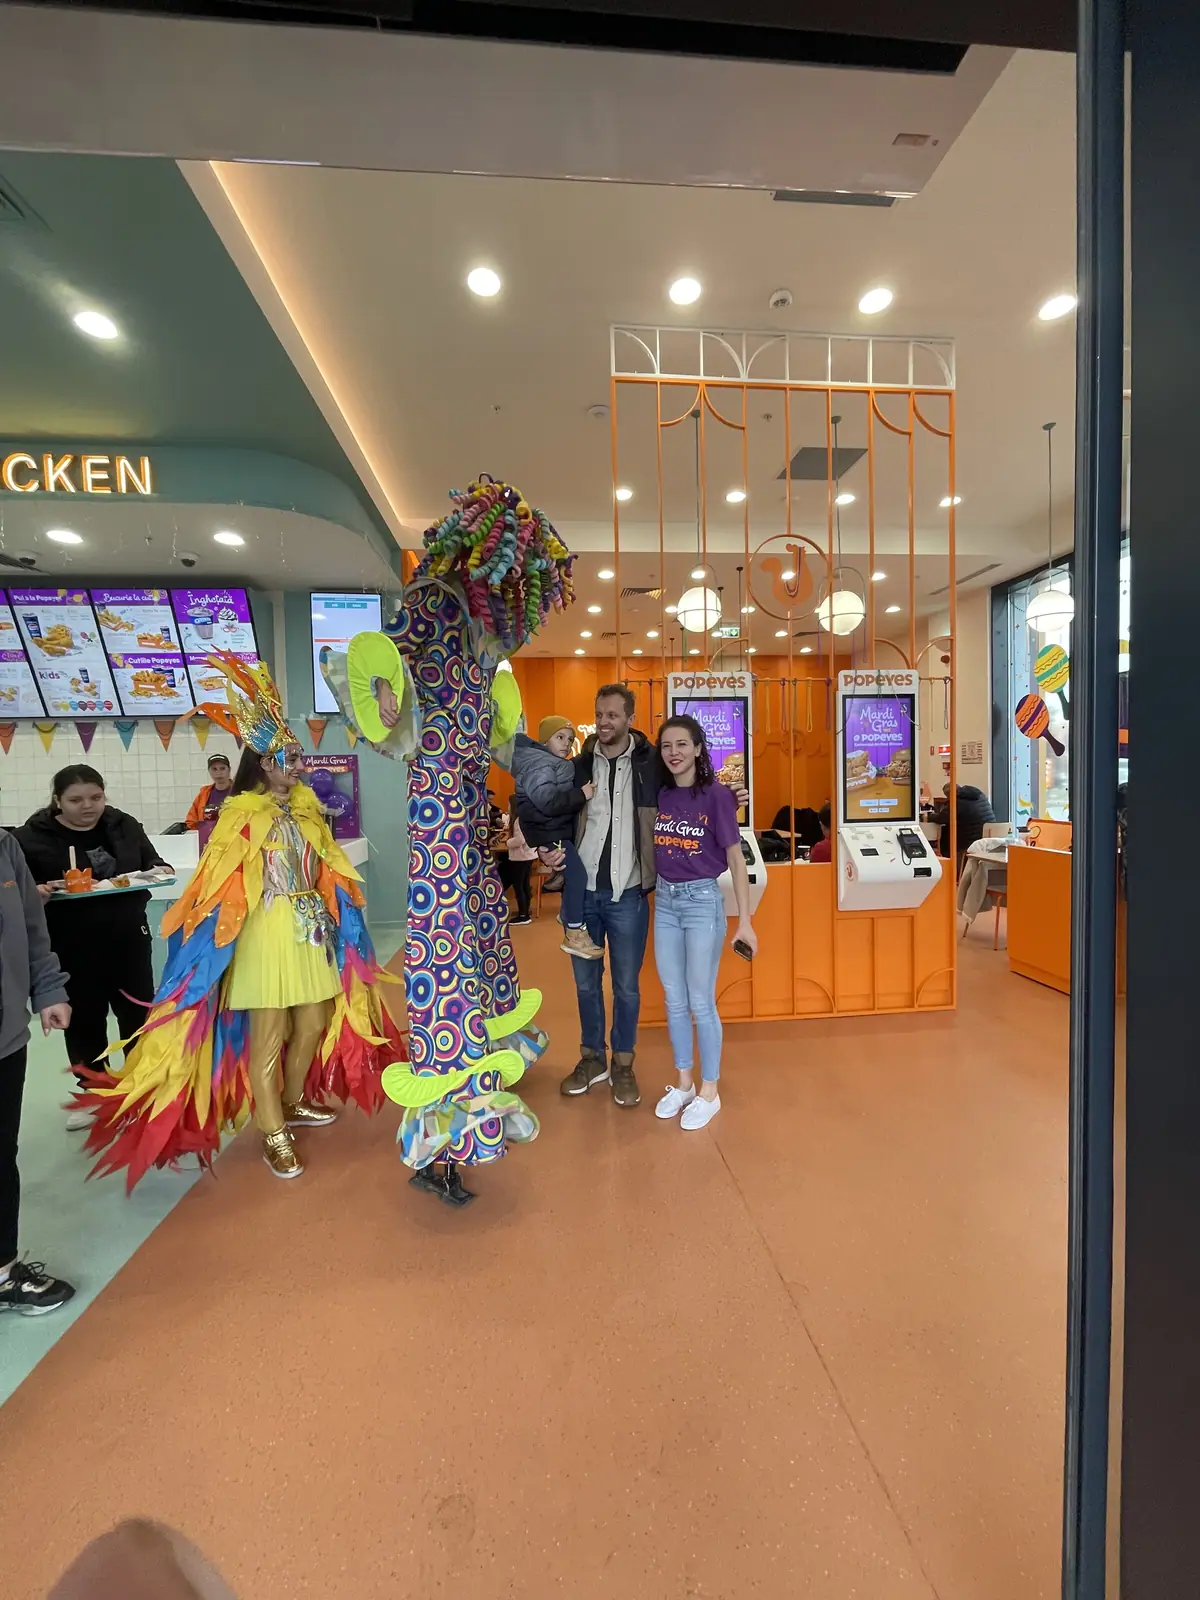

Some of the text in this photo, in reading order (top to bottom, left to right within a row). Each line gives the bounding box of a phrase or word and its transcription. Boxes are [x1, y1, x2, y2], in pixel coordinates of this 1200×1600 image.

[2, 452, 152, 495] CKEN
[103, 593, 132, 602] Bucurie
[151, 657, 181, 665] Popeyes
[692, 709, 728, 727] Mardi
[859, 706, 895, 723] Mardi
[703, 722, 731, 737] Gras
[871, 719, 898, 733] Gras
[305, 756, 348, 767] Mardi Gras
[654, 816, 705, 837] ardi Gras
